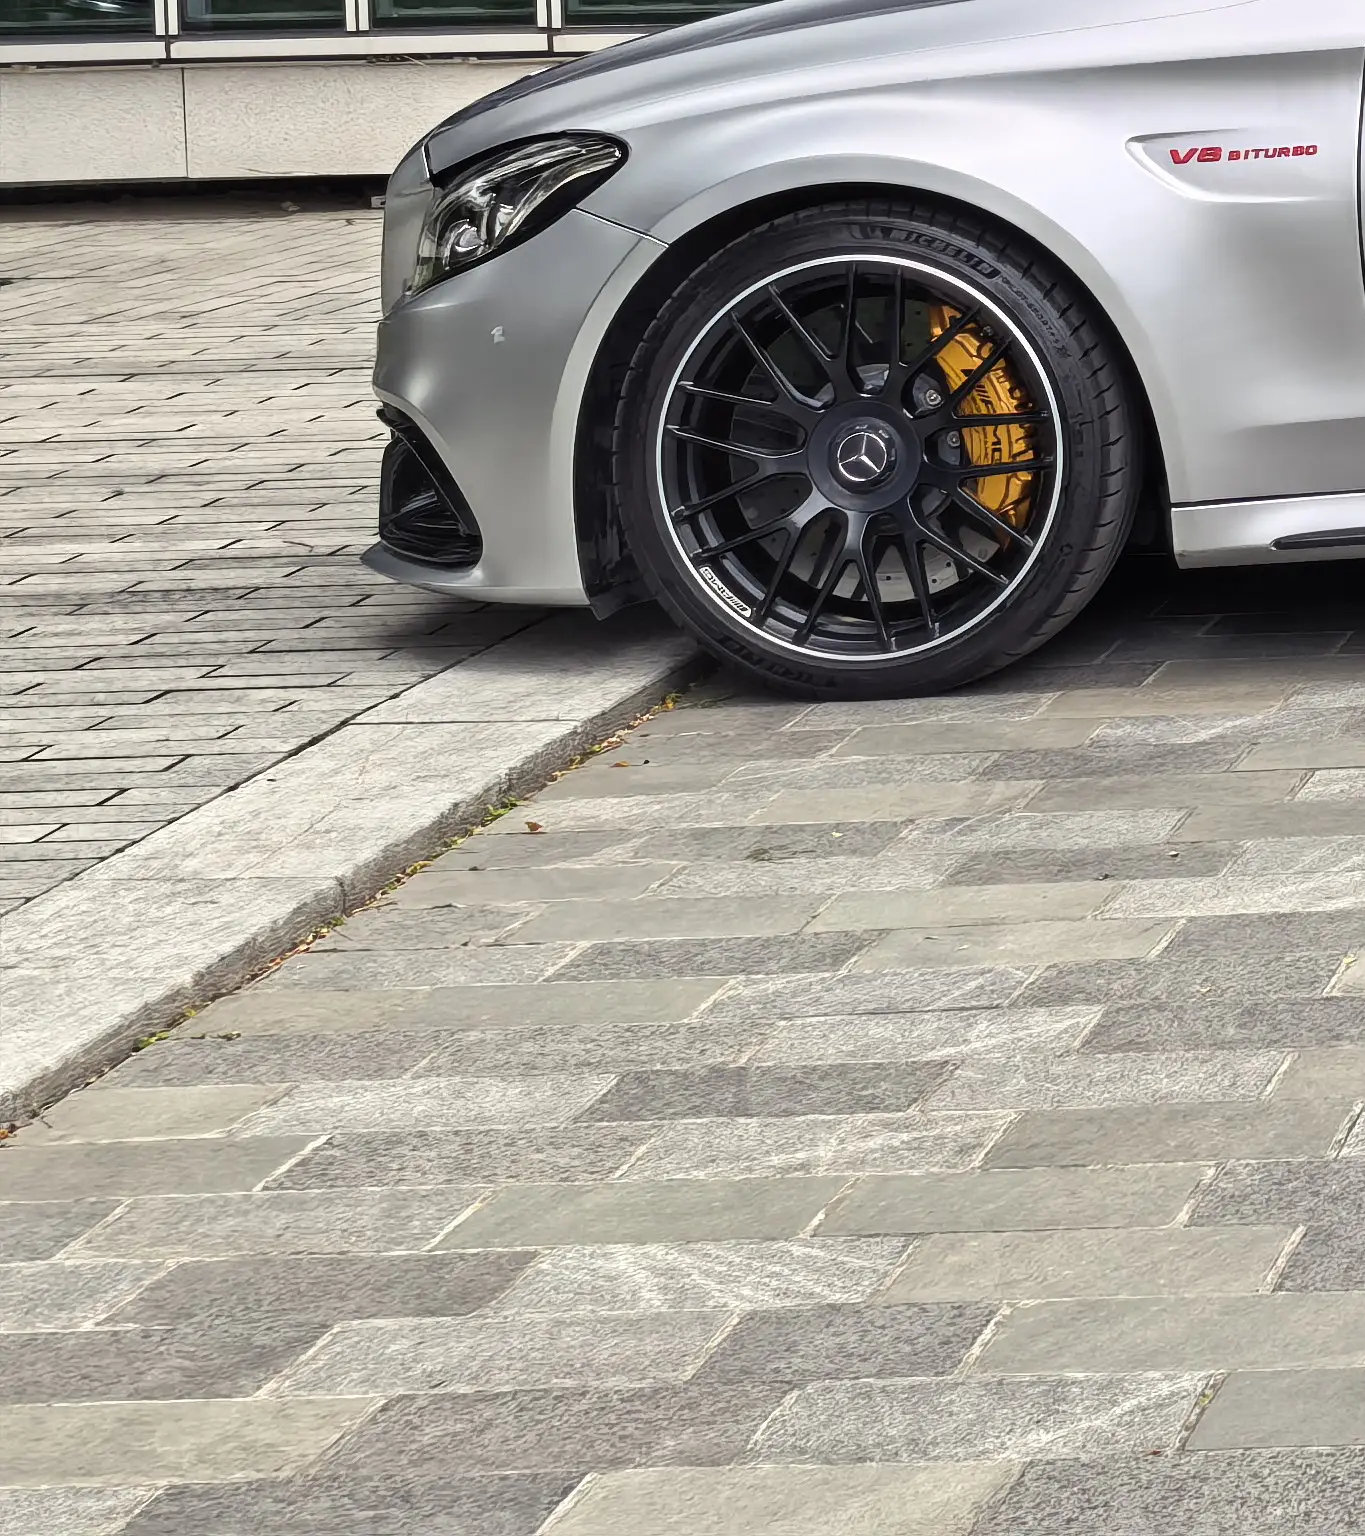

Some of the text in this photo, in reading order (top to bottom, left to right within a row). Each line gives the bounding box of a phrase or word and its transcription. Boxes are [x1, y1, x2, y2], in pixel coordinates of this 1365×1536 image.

[1169, 144, 1318, 164] V8 BITURBO
[889, 229, 996, 276] MICHELIN
